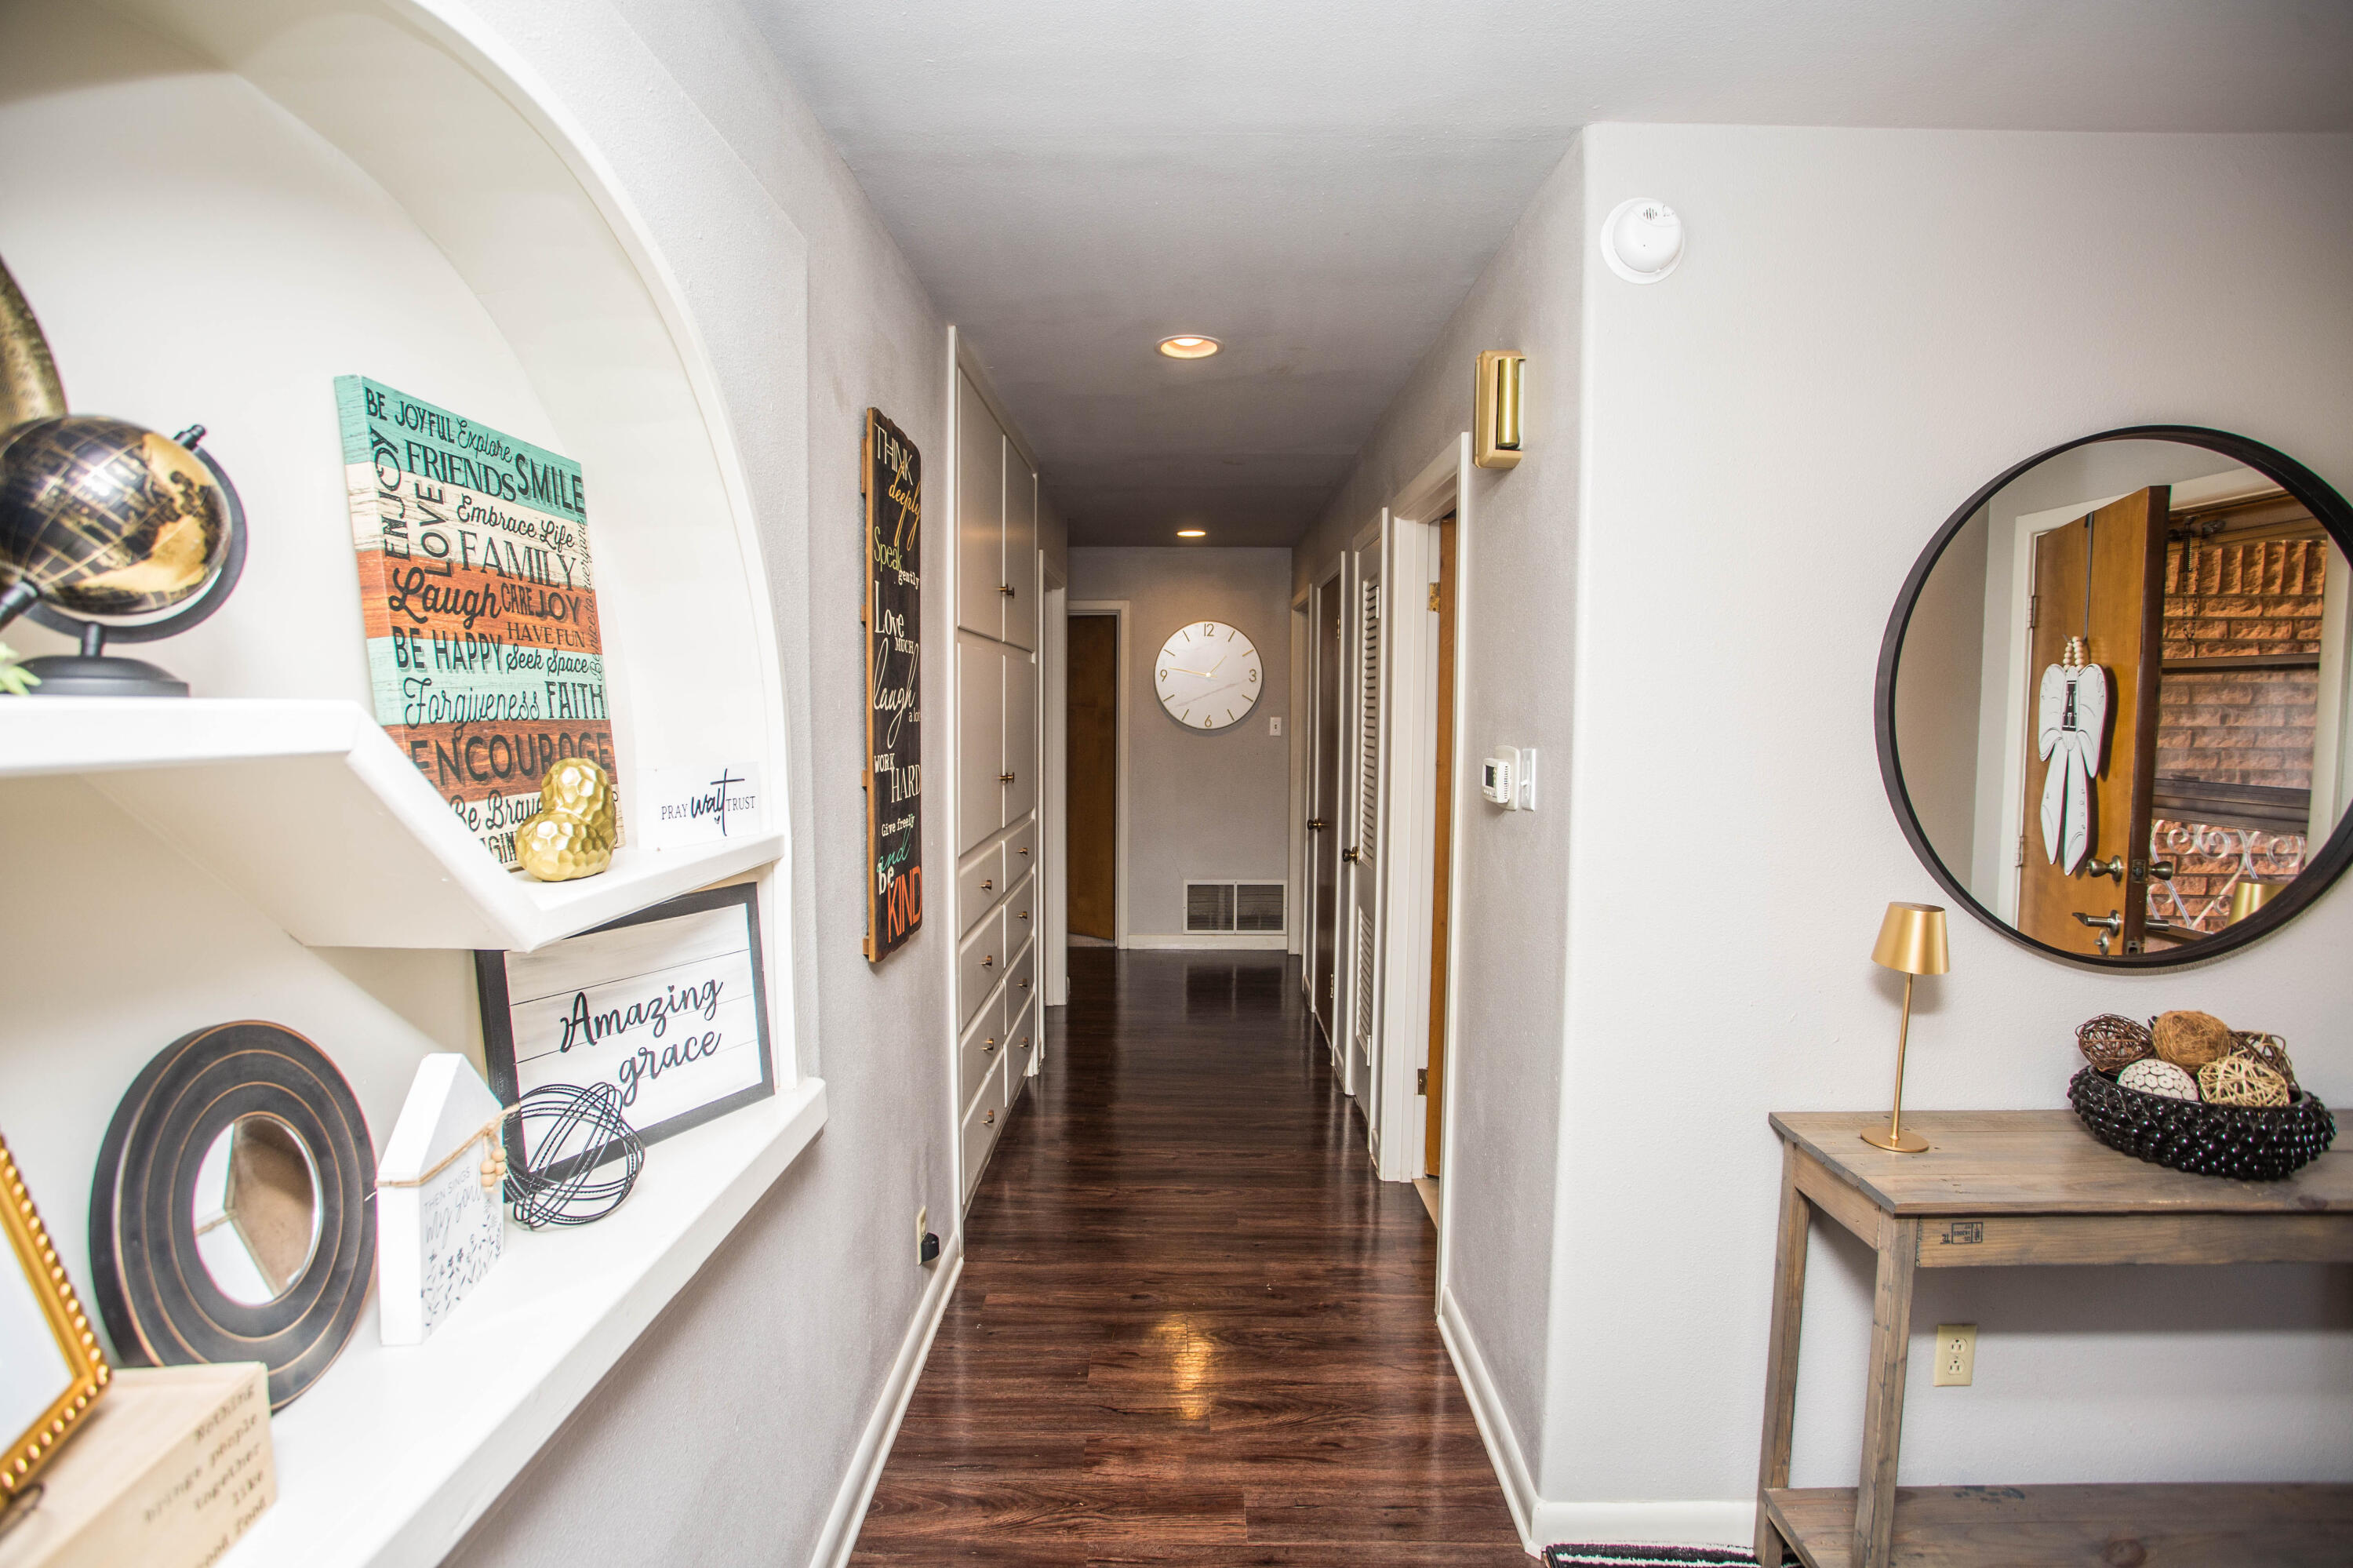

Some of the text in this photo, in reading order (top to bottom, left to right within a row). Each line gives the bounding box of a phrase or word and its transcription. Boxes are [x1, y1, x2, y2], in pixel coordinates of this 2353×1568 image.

[365, 386, 586, 513] BE JOYFUL Explore SMILE
[405, 439, 518, 503] FRIENDS
[874, 422, 914, 486] THINK
[369, 424, 411, 562] ENJOY
[456, 493, 576, 551] Embrace Life
[888, 460, 921, 551] deeply
[415, 482, 453, 578] LOVE
[458, 529, 577, 592] FAMILY
[873, 526, 920, 590] Speak gently
[388, 566, 580, 629] Laugh CARE JOY
[392, 625, 589, 677] BE HAPPY Seek Space
[507, 621, 586, 648] HAVE FUN
[894, 636, 915, 654] MUCH
[1204, 623, 1215, 637] 12
[873, 637, 920, 750] laugh
[1160, 669, 1168, 682] 9
[1249, 668, 1257, 682] 3
[402, 676, 607, 741] Forgiveness FAITH
[1204, 715, 1212, 728] 6
[661, 768, 755, 837] PRAY wait TRUST
[874, 752, 922, 804] WORK HARD
[882, 813, 915, 838] Give freely
[878, 862, 922, 944] be KIND
[559, 977, 724, 1053] Amazing
[619, 1030, 722, 1108] grace
